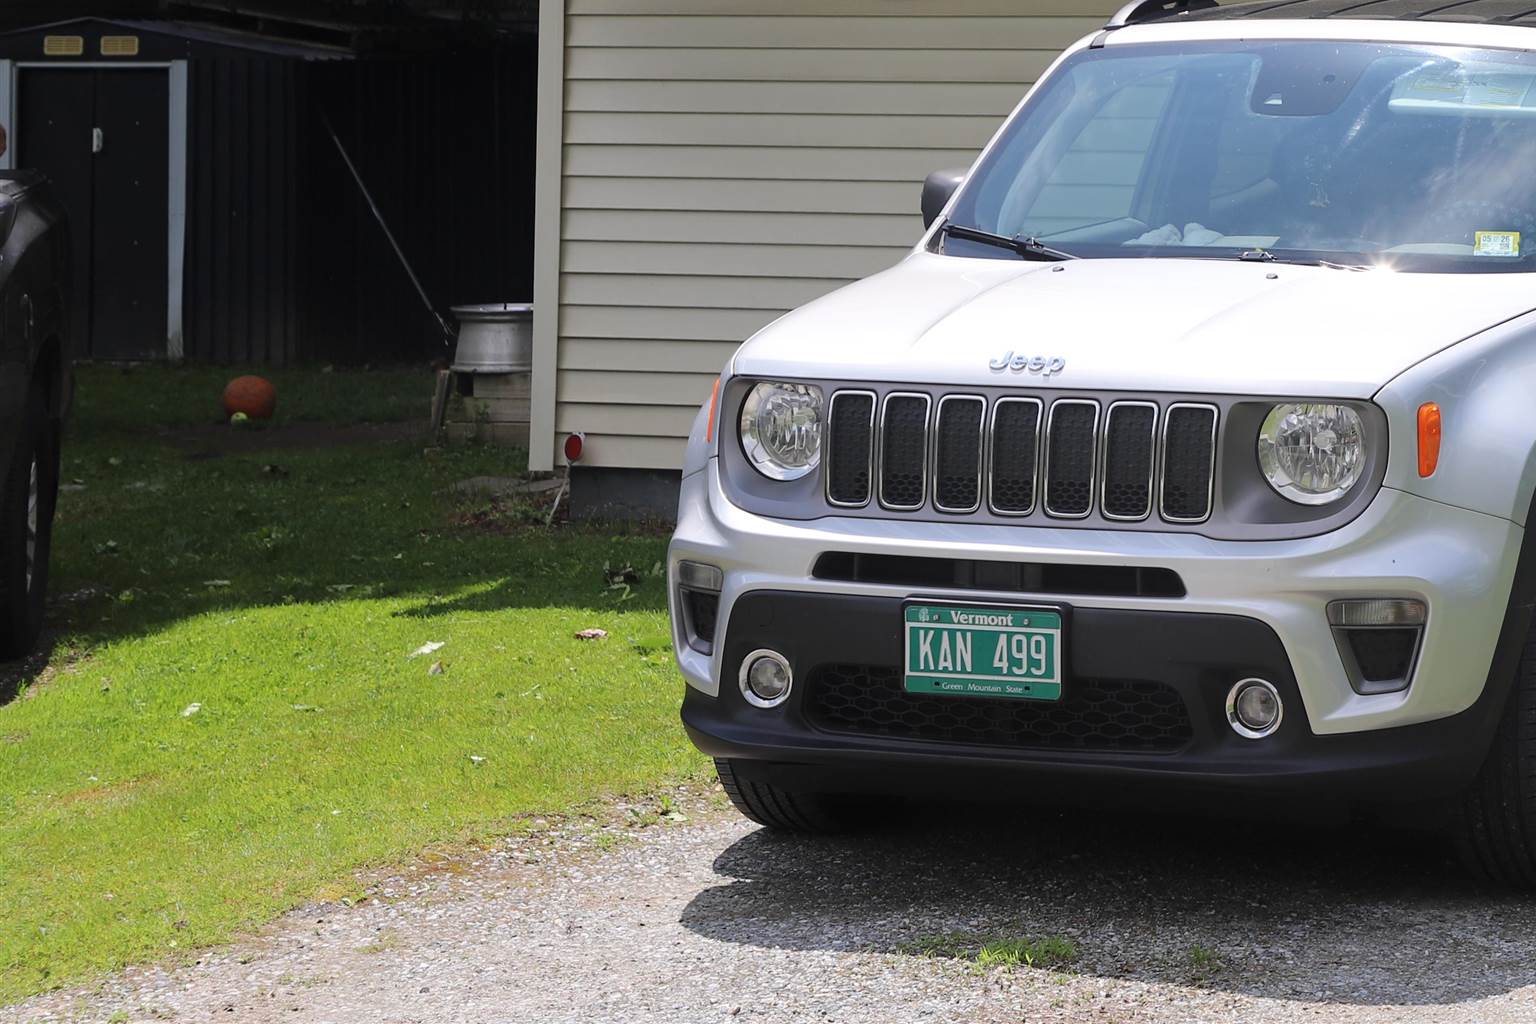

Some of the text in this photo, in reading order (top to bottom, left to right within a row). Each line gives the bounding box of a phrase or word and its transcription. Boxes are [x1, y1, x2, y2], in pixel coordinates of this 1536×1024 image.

[989, 351, 1065, 377] Jeep
[950, 610, 1013, 626] Vermont
[919, 629, 1047, 676] KAN 499
[942, 682, 1023, 693] Green Mountain State
